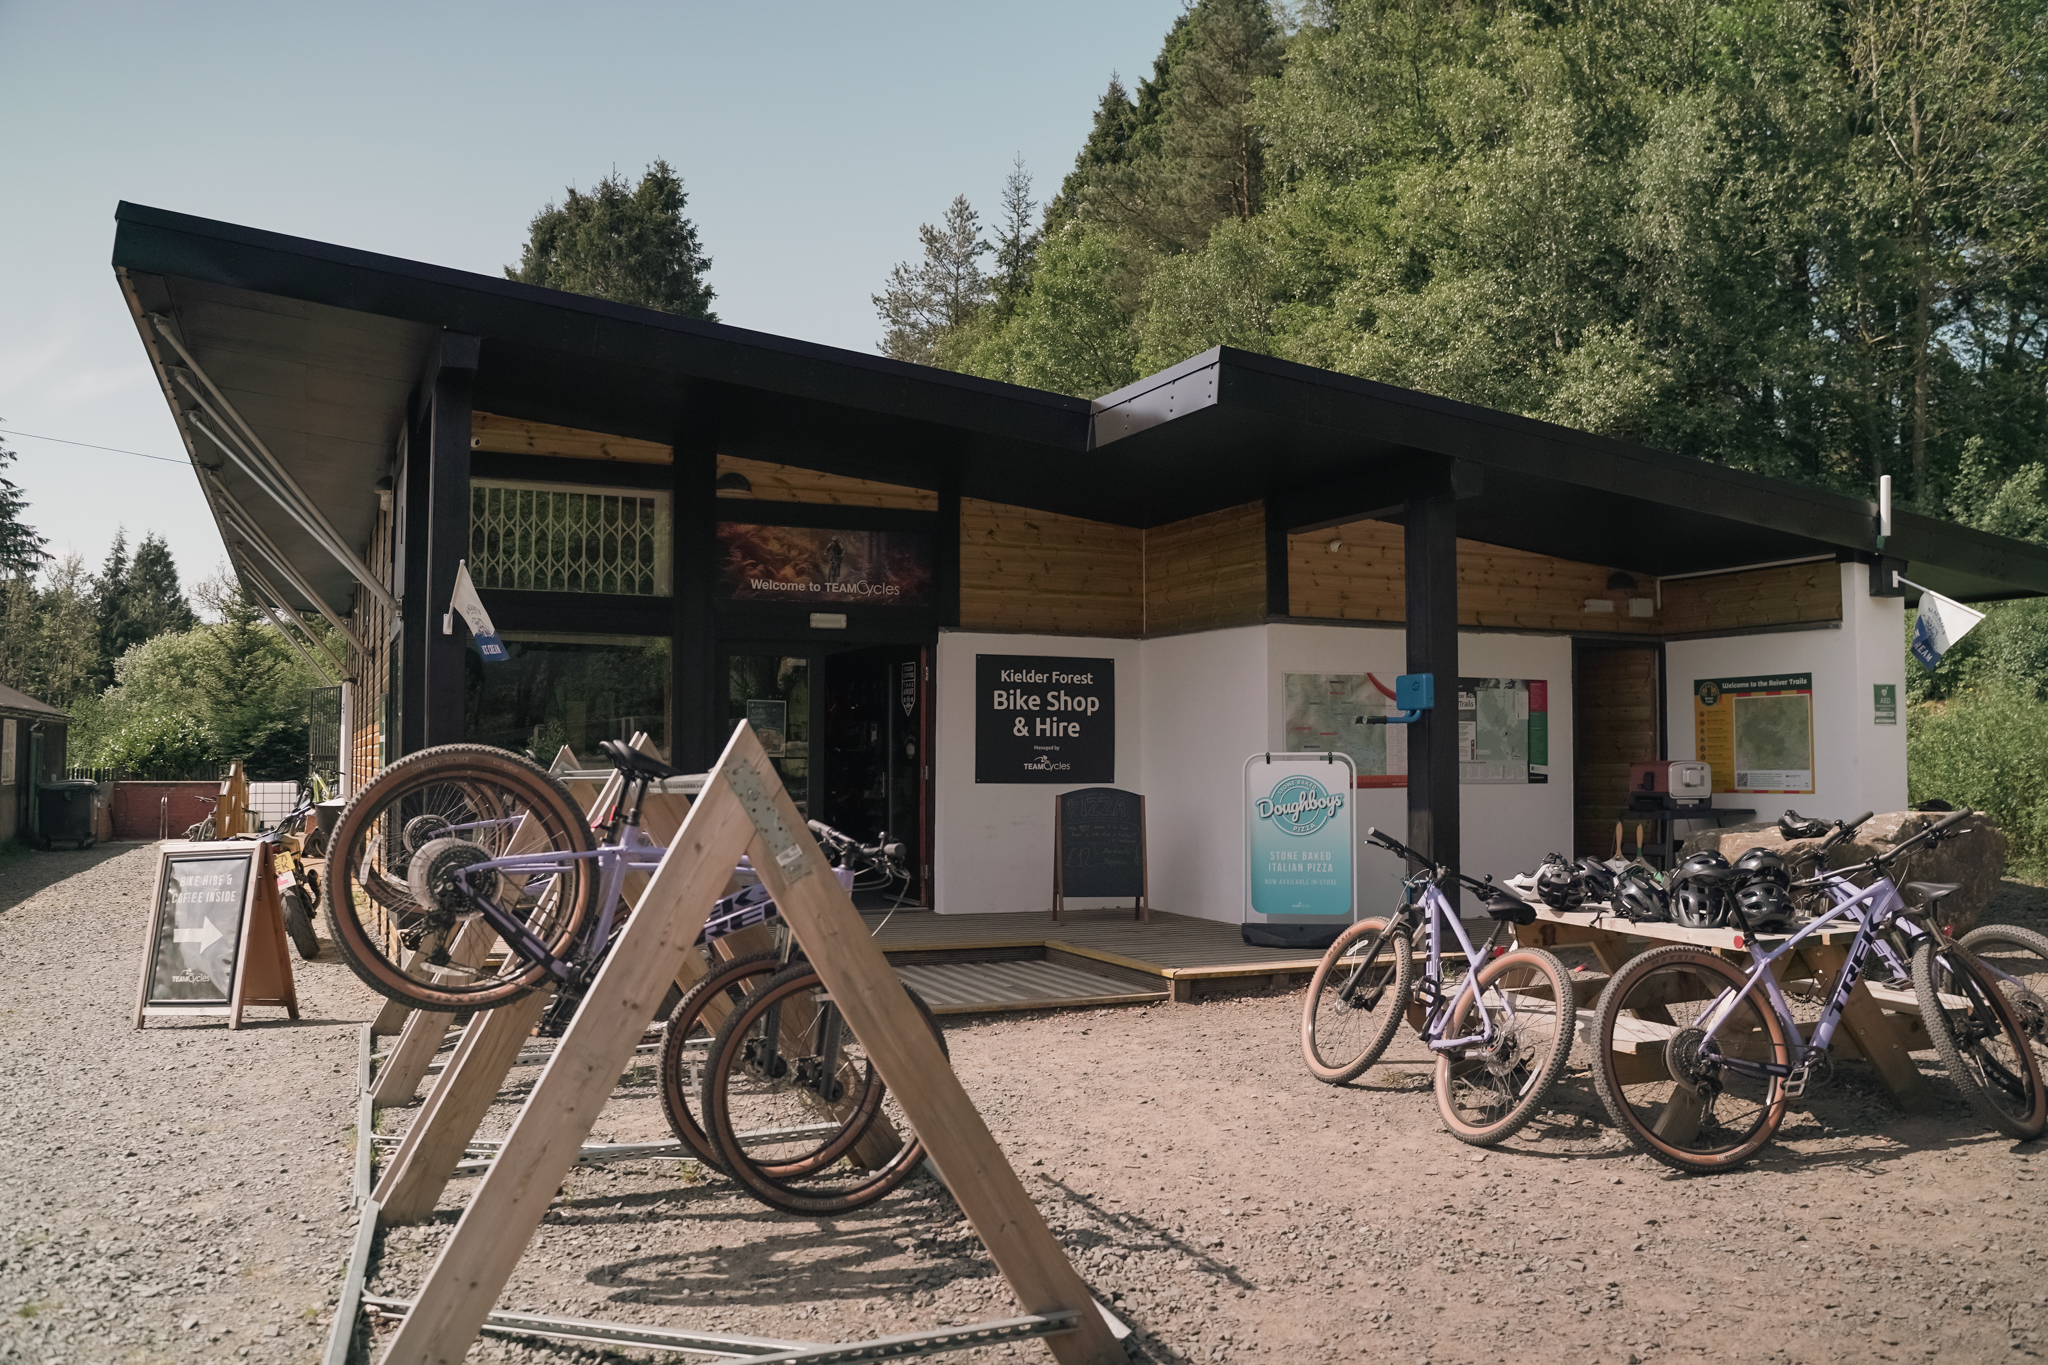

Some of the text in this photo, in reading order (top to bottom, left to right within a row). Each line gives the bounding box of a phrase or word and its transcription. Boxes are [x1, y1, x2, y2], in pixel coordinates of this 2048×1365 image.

[751, 579, 805, 591] Welcome
[809, 582, 821, 591] to
[1001, 669, 1093, 685] Kielder Forest
[993, 689, 1100, 716] Bike Shop
[1013, 716, 1080, 737] & Hire
[1278, 779, 1317, 795] STONE BAKED
[1067, 796, 1126, 818] PIZZA
[1256, 789, 1343, 823] Doughboys
[1292, 823, 1316, 833] PIZZA
[1270, 851, 1332, 861] STONE BAKED
[1268, 862, 1334, 873] ITALIAN PIZZA
[179, 873, 233, 887] BIKE HIRE &
[1279, 878, 1310, 886] AVAILABLE
[1310, 878, 1338, 886] IN-STORE
[171, 890, 237, 904] COFFEE INSIDE
[1327, 931, 1352, 959] MAXXIS
[1651, 954, 1697, 967] MAXXIS
[1829, 913, 1881, 1017] TREK
